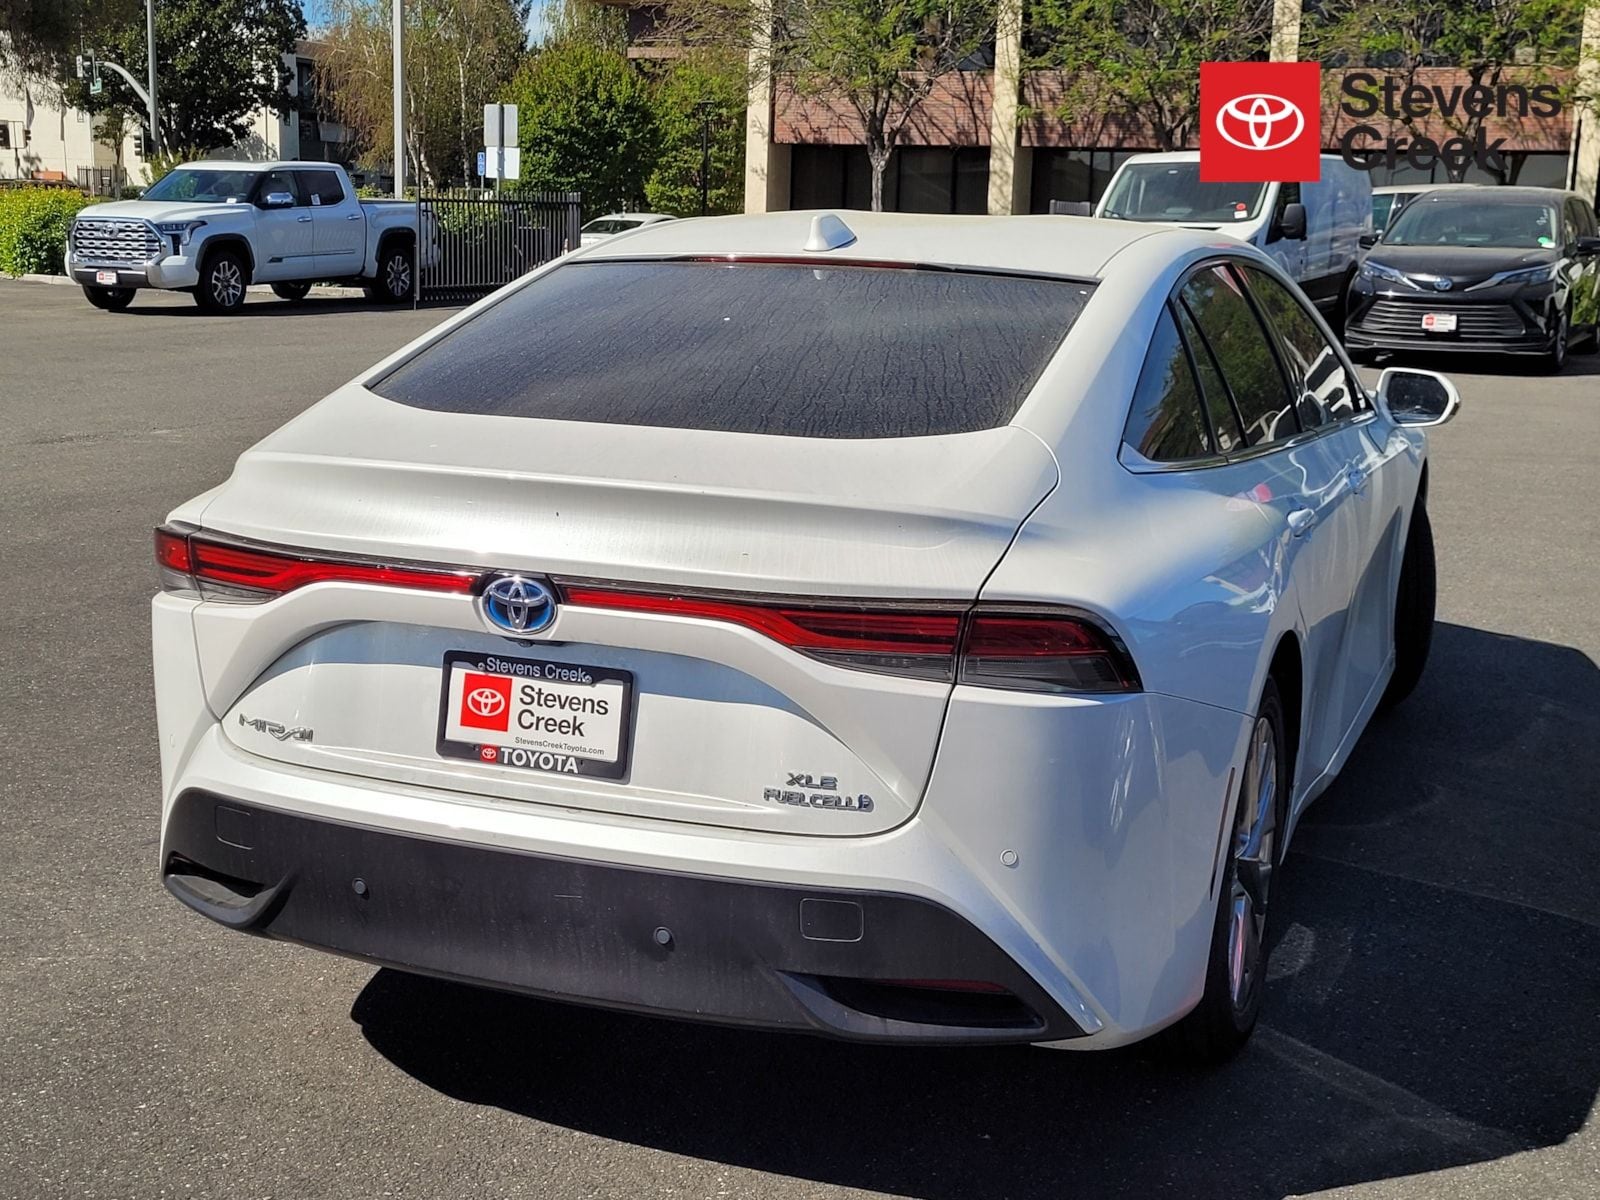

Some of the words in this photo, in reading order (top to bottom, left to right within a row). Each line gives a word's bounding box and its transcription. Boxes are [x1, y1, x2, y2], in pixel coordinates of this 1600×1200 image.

[486, 657, 541, 677] Stevens
[544, 666, 586, 682] Creek
[519, 684, 609, 716] Stevens
[517, 708, 585, 738] Creek
[514, 736, 605, 755] StevensCreekToyota.com
[500, 747, 579, 774] TOYOTA
[785, 772, 838, 790] XLE
